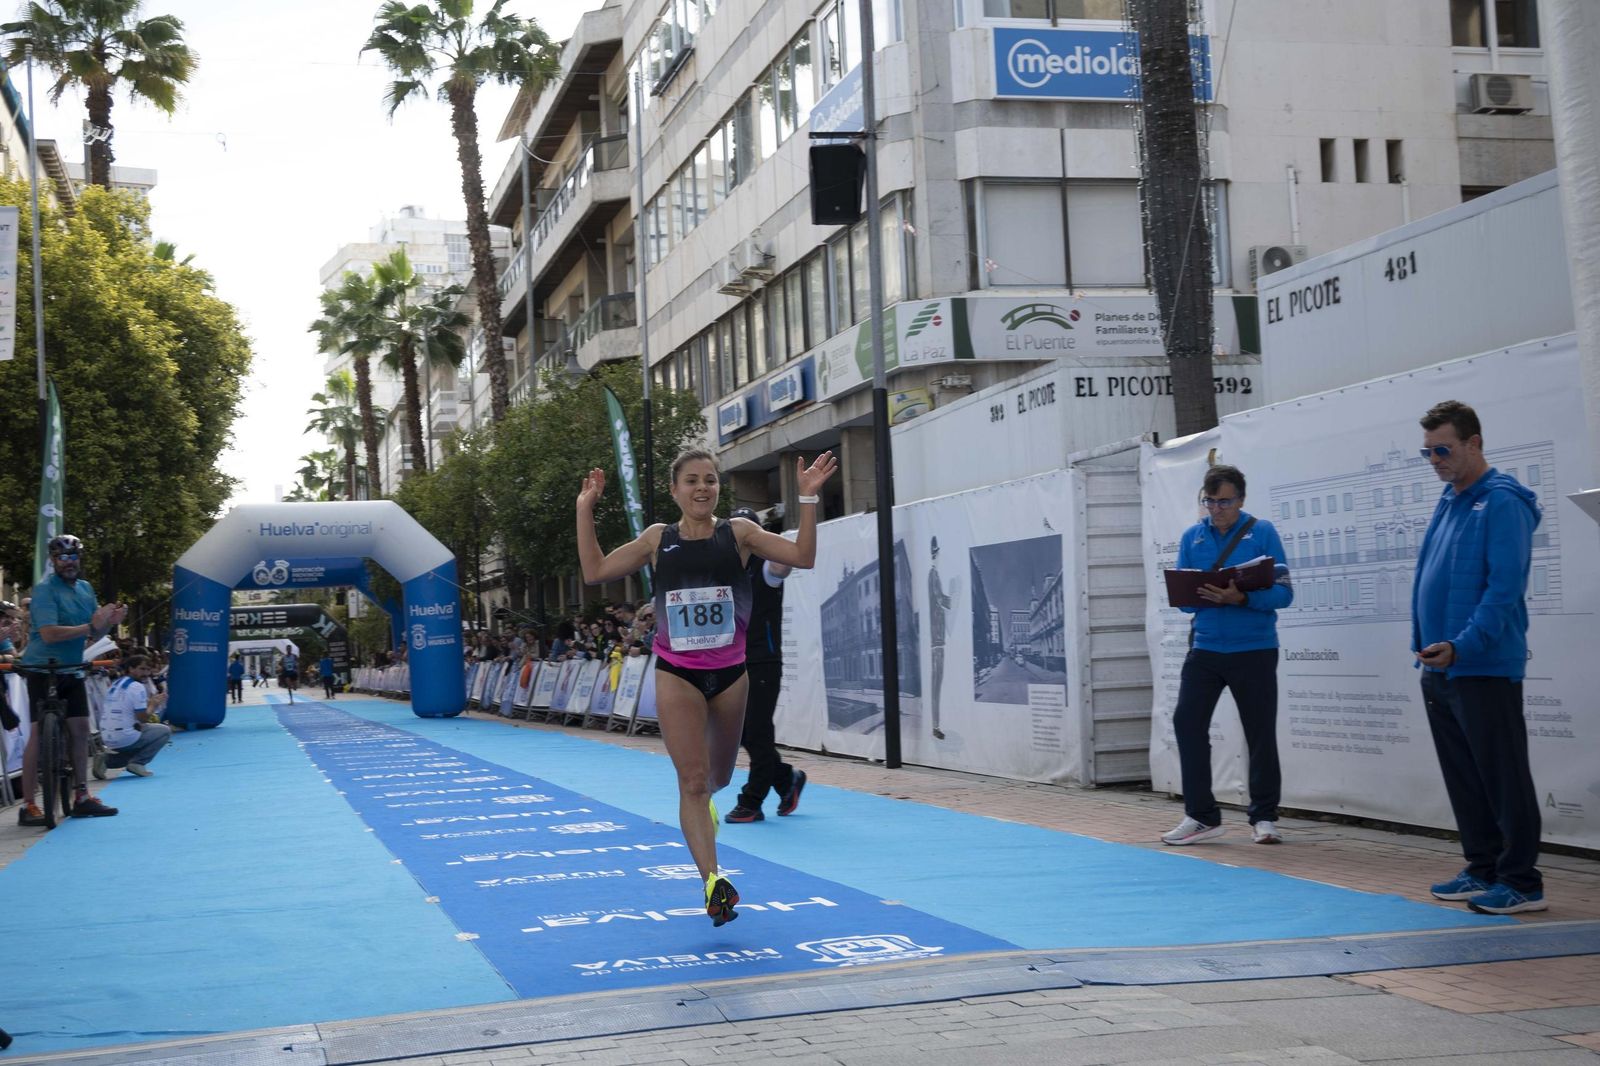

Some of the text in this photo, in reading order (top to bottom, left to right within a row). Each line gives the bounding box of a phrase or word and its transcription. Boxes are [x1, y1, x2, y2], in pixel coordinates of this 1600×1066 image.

[1017, 46, 1142, 76] mediola
[1267, 251, 1417, 324] EL PICOTE 481
[1095, 313, 1131, 322] Planes
[1132, 312, 1146, 321] de
[1096, 325, 1149, 334] Familiares
[1006, 334, 1077, 351] El Puente
[904, 346, 947, 361] La Paz
[1075, 376, 1099, 398] EL
[1107, 375, 1174, 397] PICOTE
[1017, 394, 1027, 414] EL
[1028, 382, 1056, 410] PICOTE
[259, 521, 372, 538] Huelva original
[670, 592, 683, 602] 2K
[716, 588, 729, 598] 2K
[175, 608, 224, 621] Huelva
[409, 603, 455, 616] Huelva
[678, 603, 724, 627] 188
[686, 635, 719, 645] Huelva
[1284, 648, 1340, 661] Localización
[542, 896, 840, 928] Huelva
[572, 947, 779, 970] HUELVA
[580, 952, 785, 977] Ayuntamiento de
